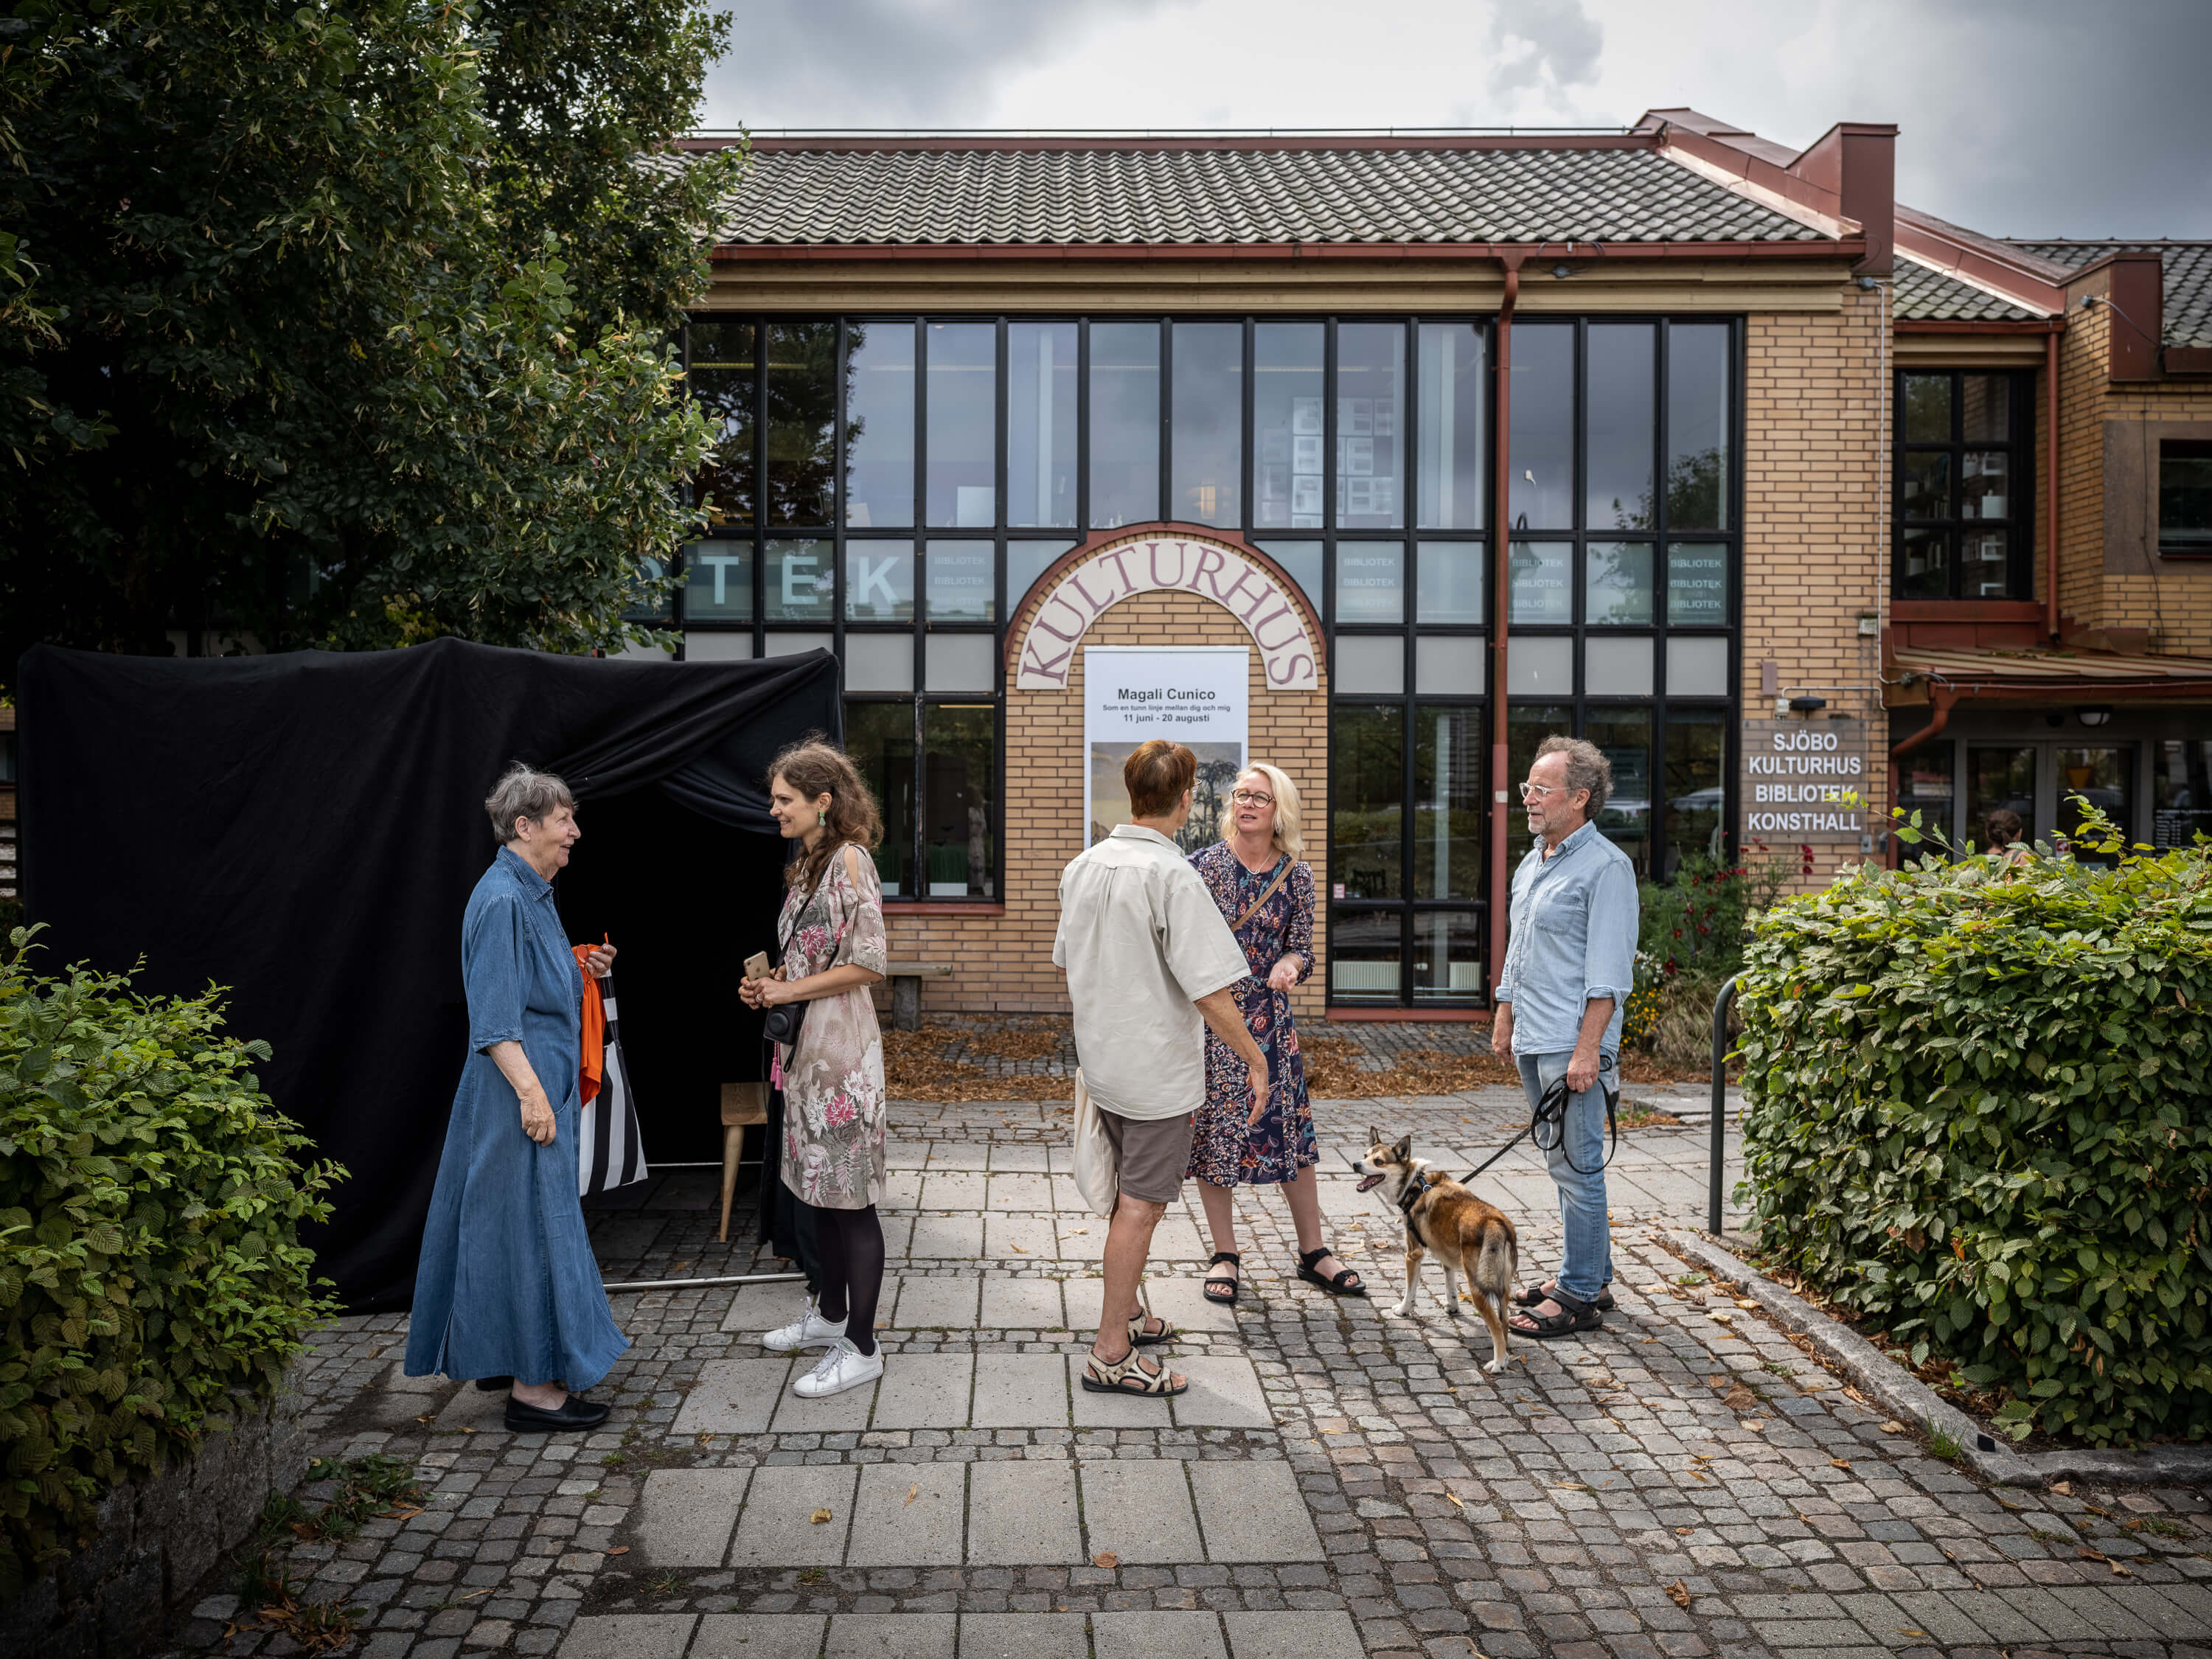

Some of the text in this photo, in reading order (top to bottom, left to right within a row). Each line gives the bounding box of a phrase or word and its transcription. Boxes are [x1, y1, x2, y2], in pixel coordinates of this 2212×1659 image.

[934, 556, 986, 566] BIBLIOTEK
[1344, 557, 1395, 566] BIBLIOTEK
[1512, 558, 1563, 567] BIBLIOTEK
[1671, 559, 1722, 568] BIBLIOTEK
[934, 577, 985, 585] BIBLIOTEK
[1343, 577, 1394, 586] BIBLIOTEK
[1512, 579, 1563, 588] BIBLIOTEK
[1670, 580, 1722, 588] BIBLIOTEK
[1670, 600, 1722, 608] BIBLIOTEK
[1020, 542, 1314, 685] KULTURHUS
[1118, 689, 1215, 702] Magali Cunico
[1124, 714, 1133, 722] 11
[1136, 714, 1153, 723] juni
[1162, 714, 1172, 722] 20
[1175, 714, 1209, 723] augusti
[1773, 729, 1837, 751] SJÖBO
[1749, 757, 1861, 774] KULTURHUS
[1748, 813, 1861, 831] KONSTHALL
